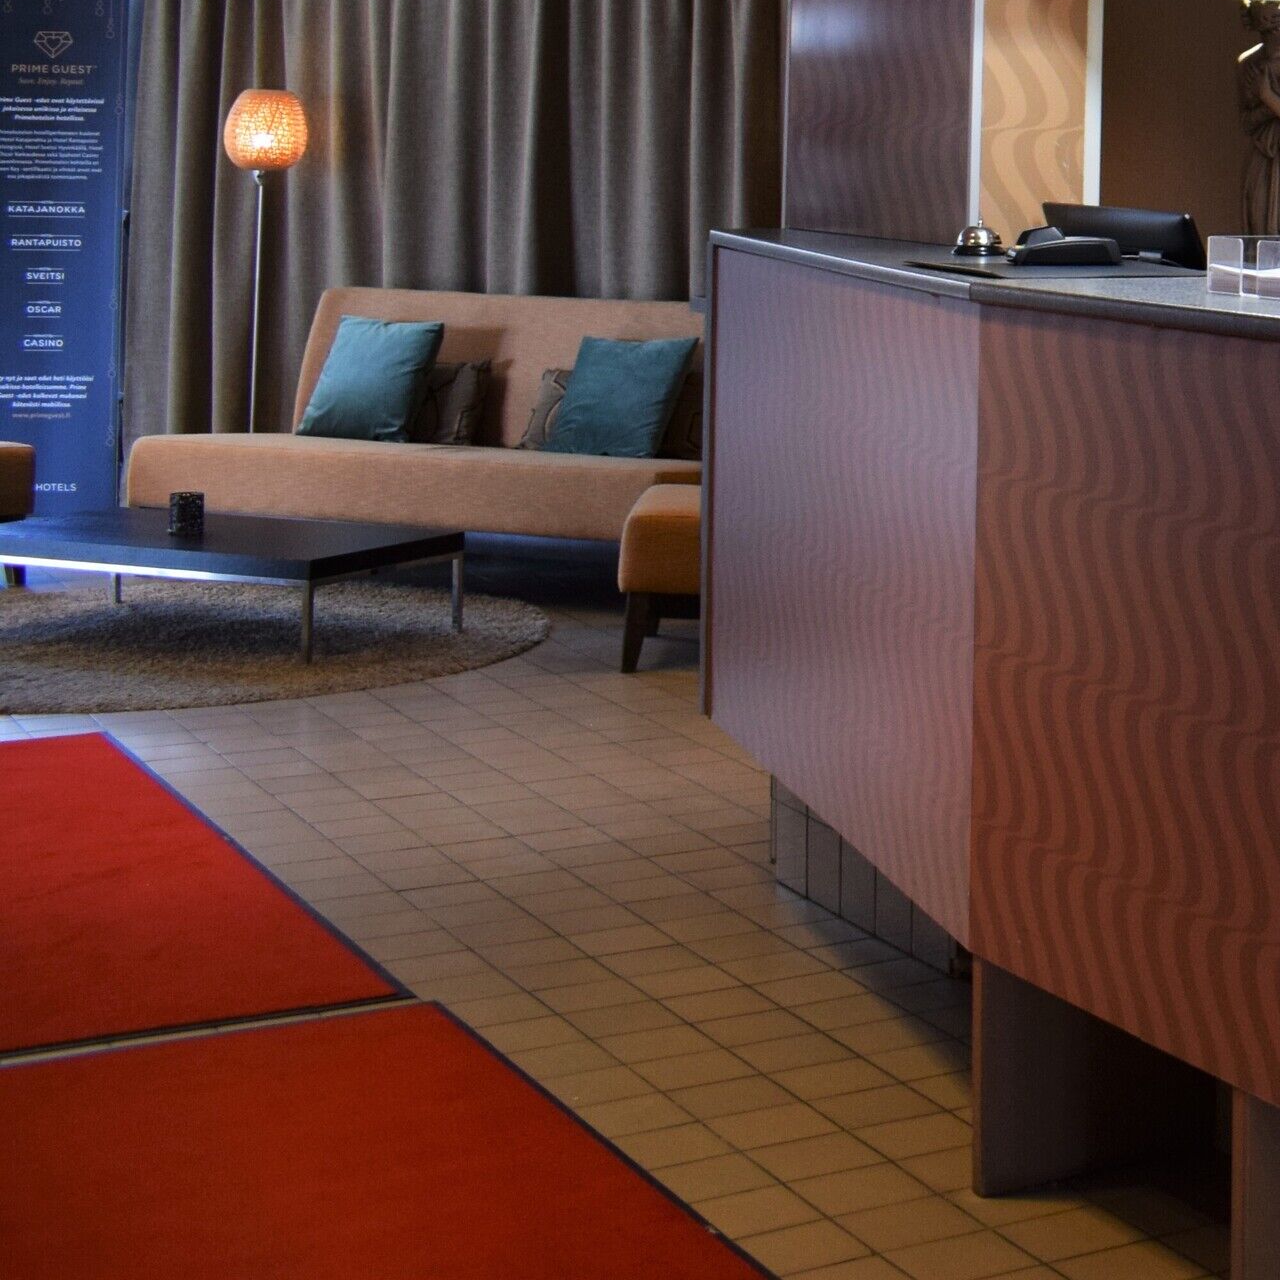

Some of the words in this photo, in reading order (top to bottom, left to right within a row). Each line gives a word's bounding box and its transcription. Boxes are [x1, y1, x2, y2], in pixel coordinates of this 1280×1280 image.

[11, 64, 49, 74] PRIME
[8, 205, 86, 214] KATAJANOKKA
[11, 238, 82, 247] RANTAPUISTO
[26, 272, 65, 280] SVEITSI
[26, 305, 62, 313] OSCAR
[23, 339, 64, 348] CASINO
